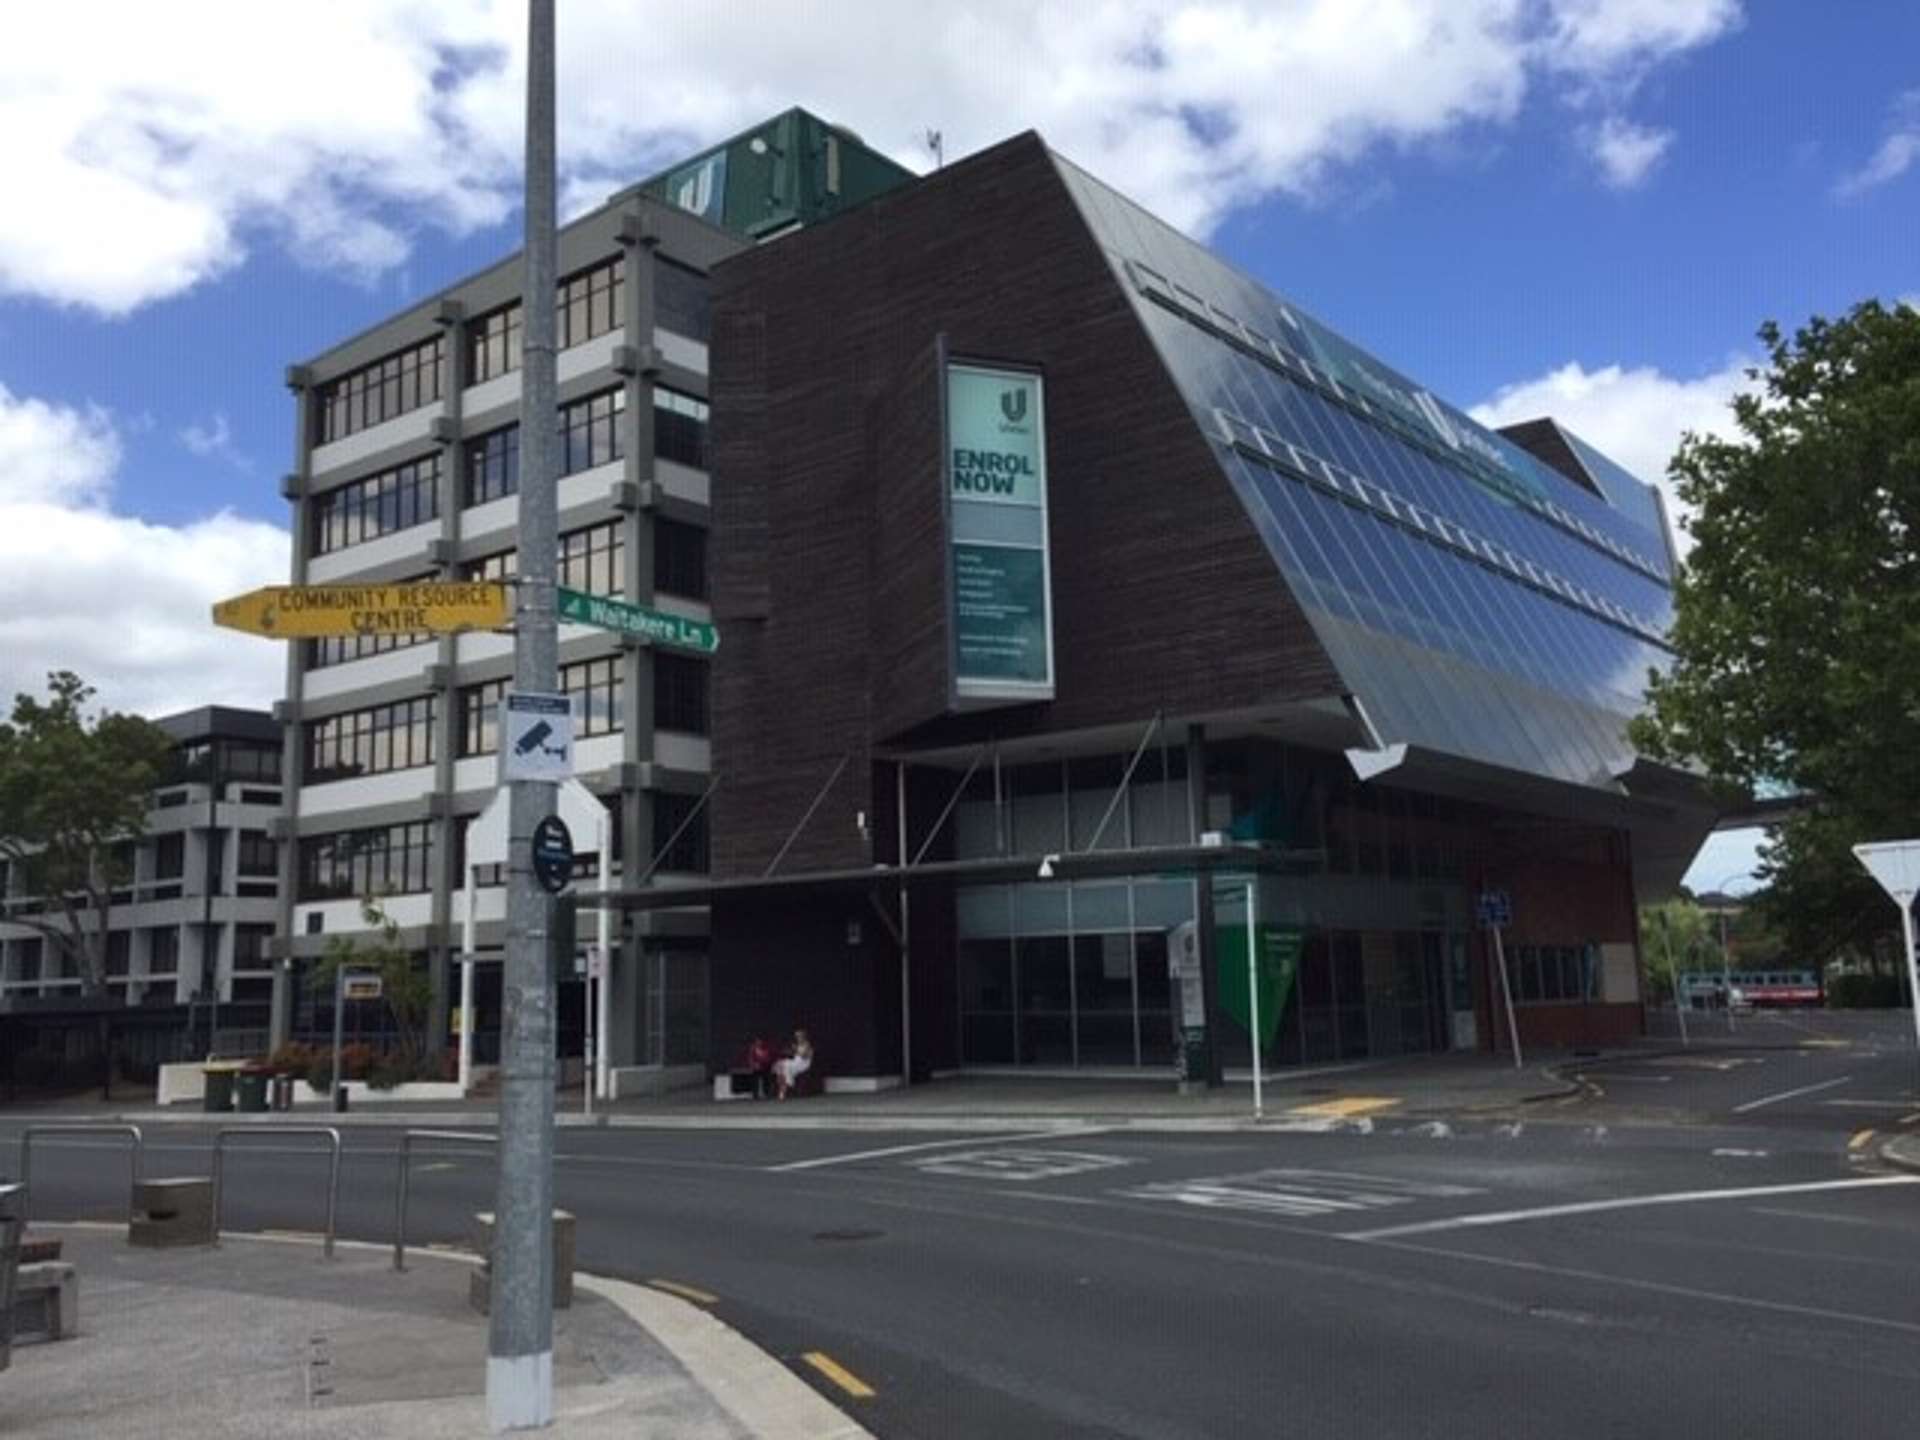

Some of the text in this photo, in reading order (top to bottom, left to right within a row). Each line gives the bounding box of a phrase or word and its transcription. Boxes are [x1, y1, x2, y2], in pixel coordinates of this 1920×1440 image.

[953, 448, 1034, 476] ENROL
[953, 470, 1015, 494] NOW
[279, 585, 489, 612] COMMUNITY RESOURCE
[351, 608, 427, 631] CENTRE
[589, 600, 702, 643] Waitakere Ln
